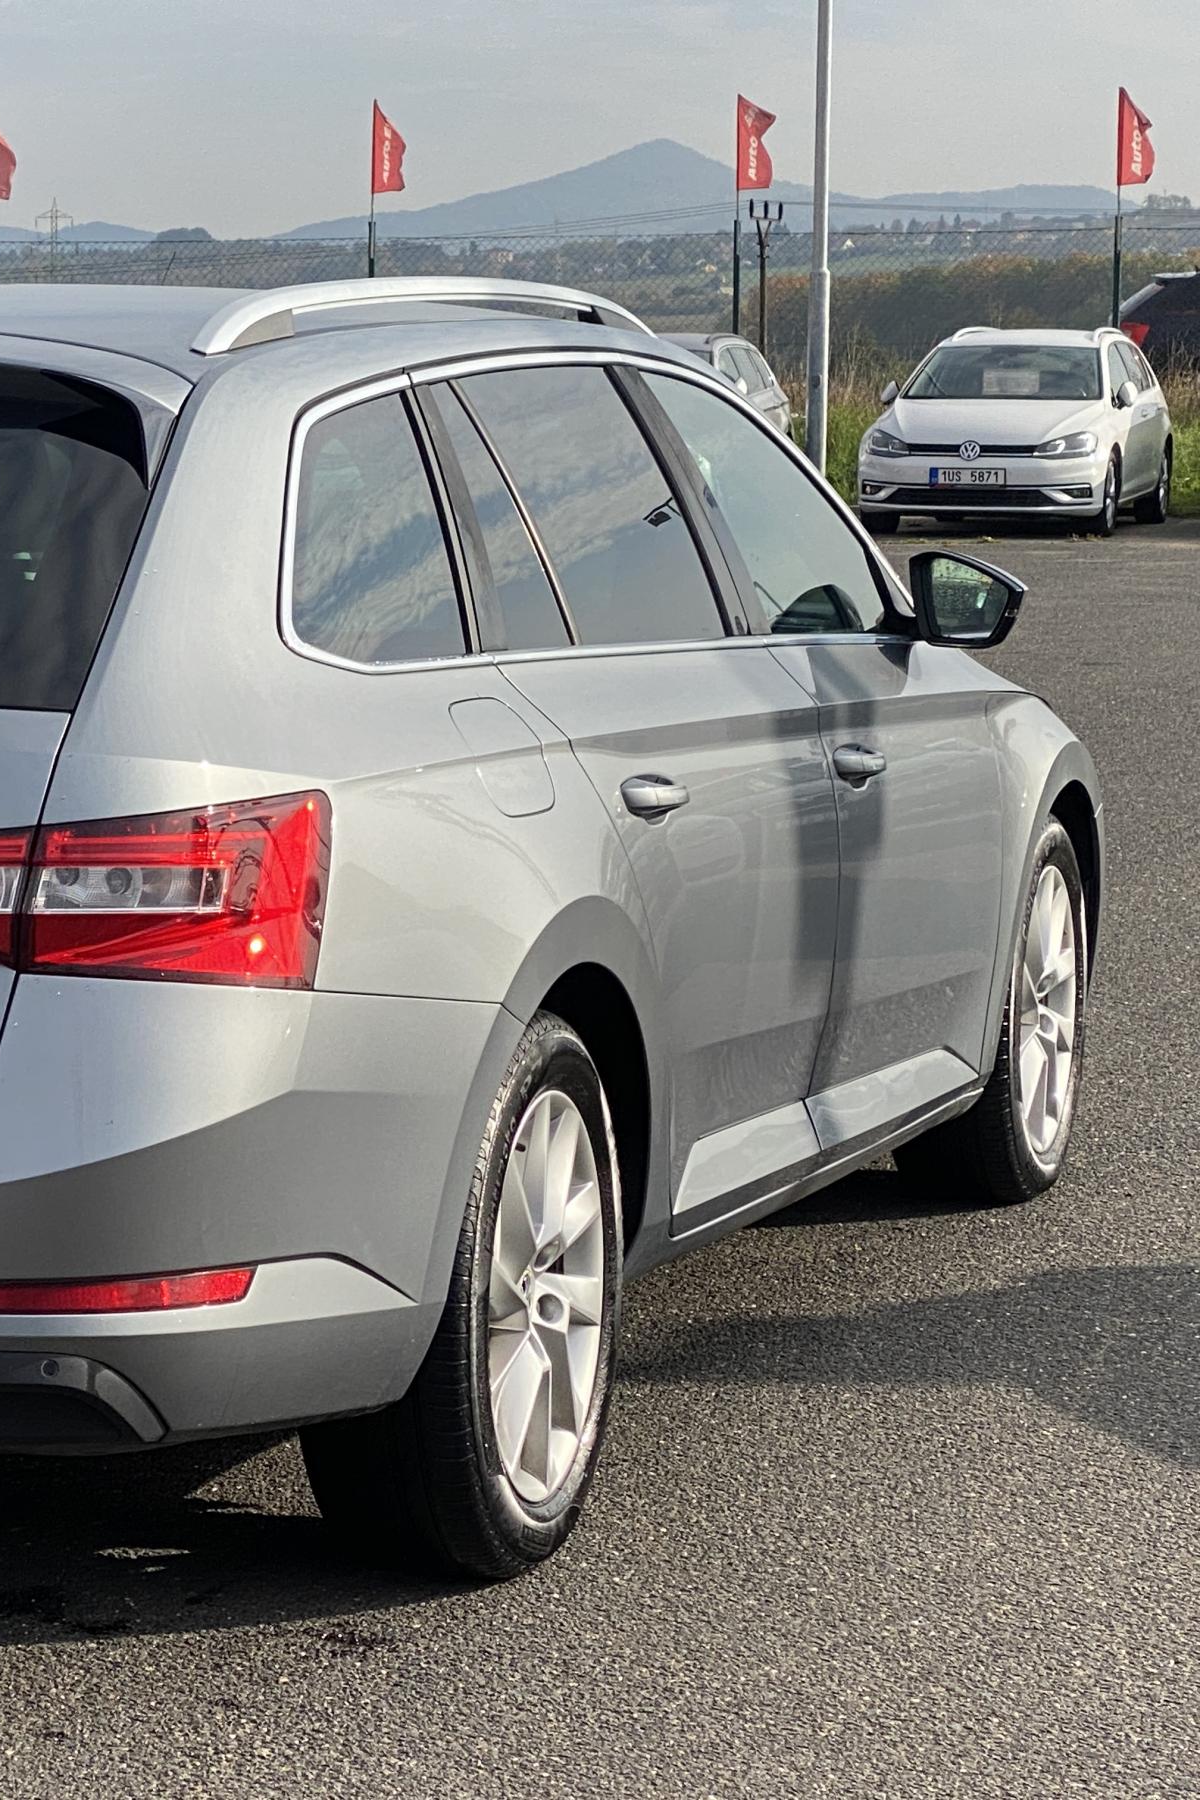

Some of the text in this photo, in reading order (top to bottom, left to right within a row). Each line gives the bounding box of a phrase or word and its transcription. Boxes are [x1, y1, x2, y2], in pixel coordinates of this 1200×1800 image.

[382, 140, 391, 186] Auto
[747, 135, 759, 182] Auto
[1131, 128, 1142, 177] Auto
[941, 470, 962, 482] 1US
[970, 471, 999, 483] 5871
